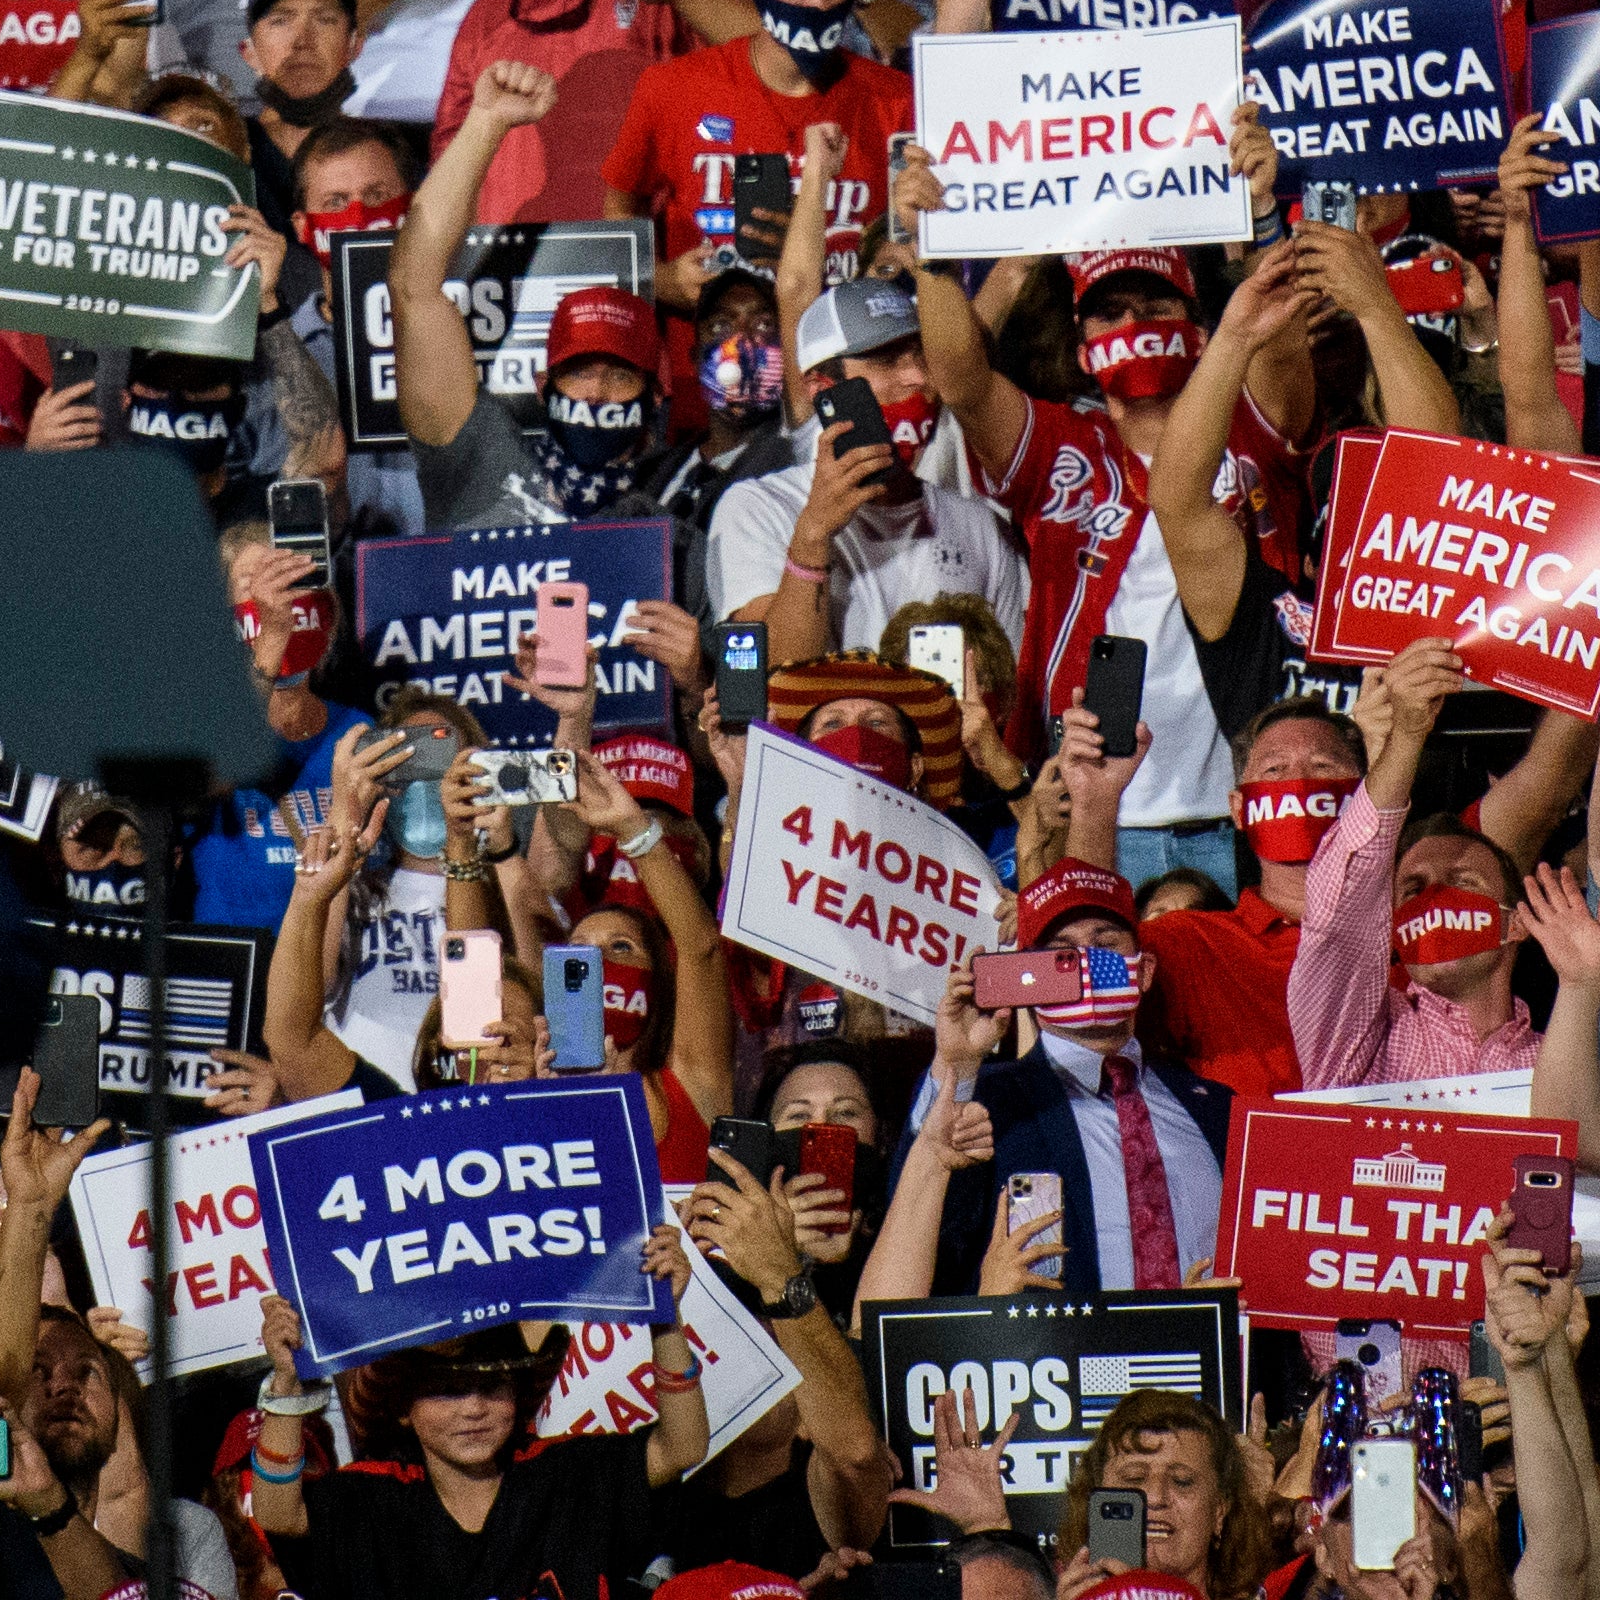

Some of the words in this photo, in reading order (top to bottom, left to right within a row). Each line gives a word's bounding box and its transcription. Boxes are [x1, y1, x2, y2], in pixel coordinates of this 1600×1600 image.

[1302, 6, 1414, 52] MAKE
[1021, 68, 1142, 103] MAKE
[1246, 47, 1496, 116] AMERICA
[942, 101, 1228, 166] AMERICA
[1384, 106, 1504, 149] AGAIN
[1093, 162, 1232, 203] AGAIN
[11, 237, 78, 266] FOR
[88, 247, 200, 282] TRUMP
[62, 294, 122, 316] 2020
[1438, 474, 1556, 535] MAKE
[452, 560, 571, 601] MAKE
[1351, 574, 1455, 619] GREAT
[781, 806, 813, 846] 4
[829, 818, 982, 919] MORE
[780, 859, 970, 969] YEARS!
[1396, 910, 1494, 947] TRUMP
[318, 1174, 368, 1224] 4
[383, 1139, 601, 1209] MORE
[1252, 1189, 1376, 1239] FILL
[332, 1206, 608, 1295] YEARS!
[1306, 1248, 1469, 1299] SEAT!
[462, 1302, 511, 1324] 2020
[906, 1354, 1074, 1436] COPS
